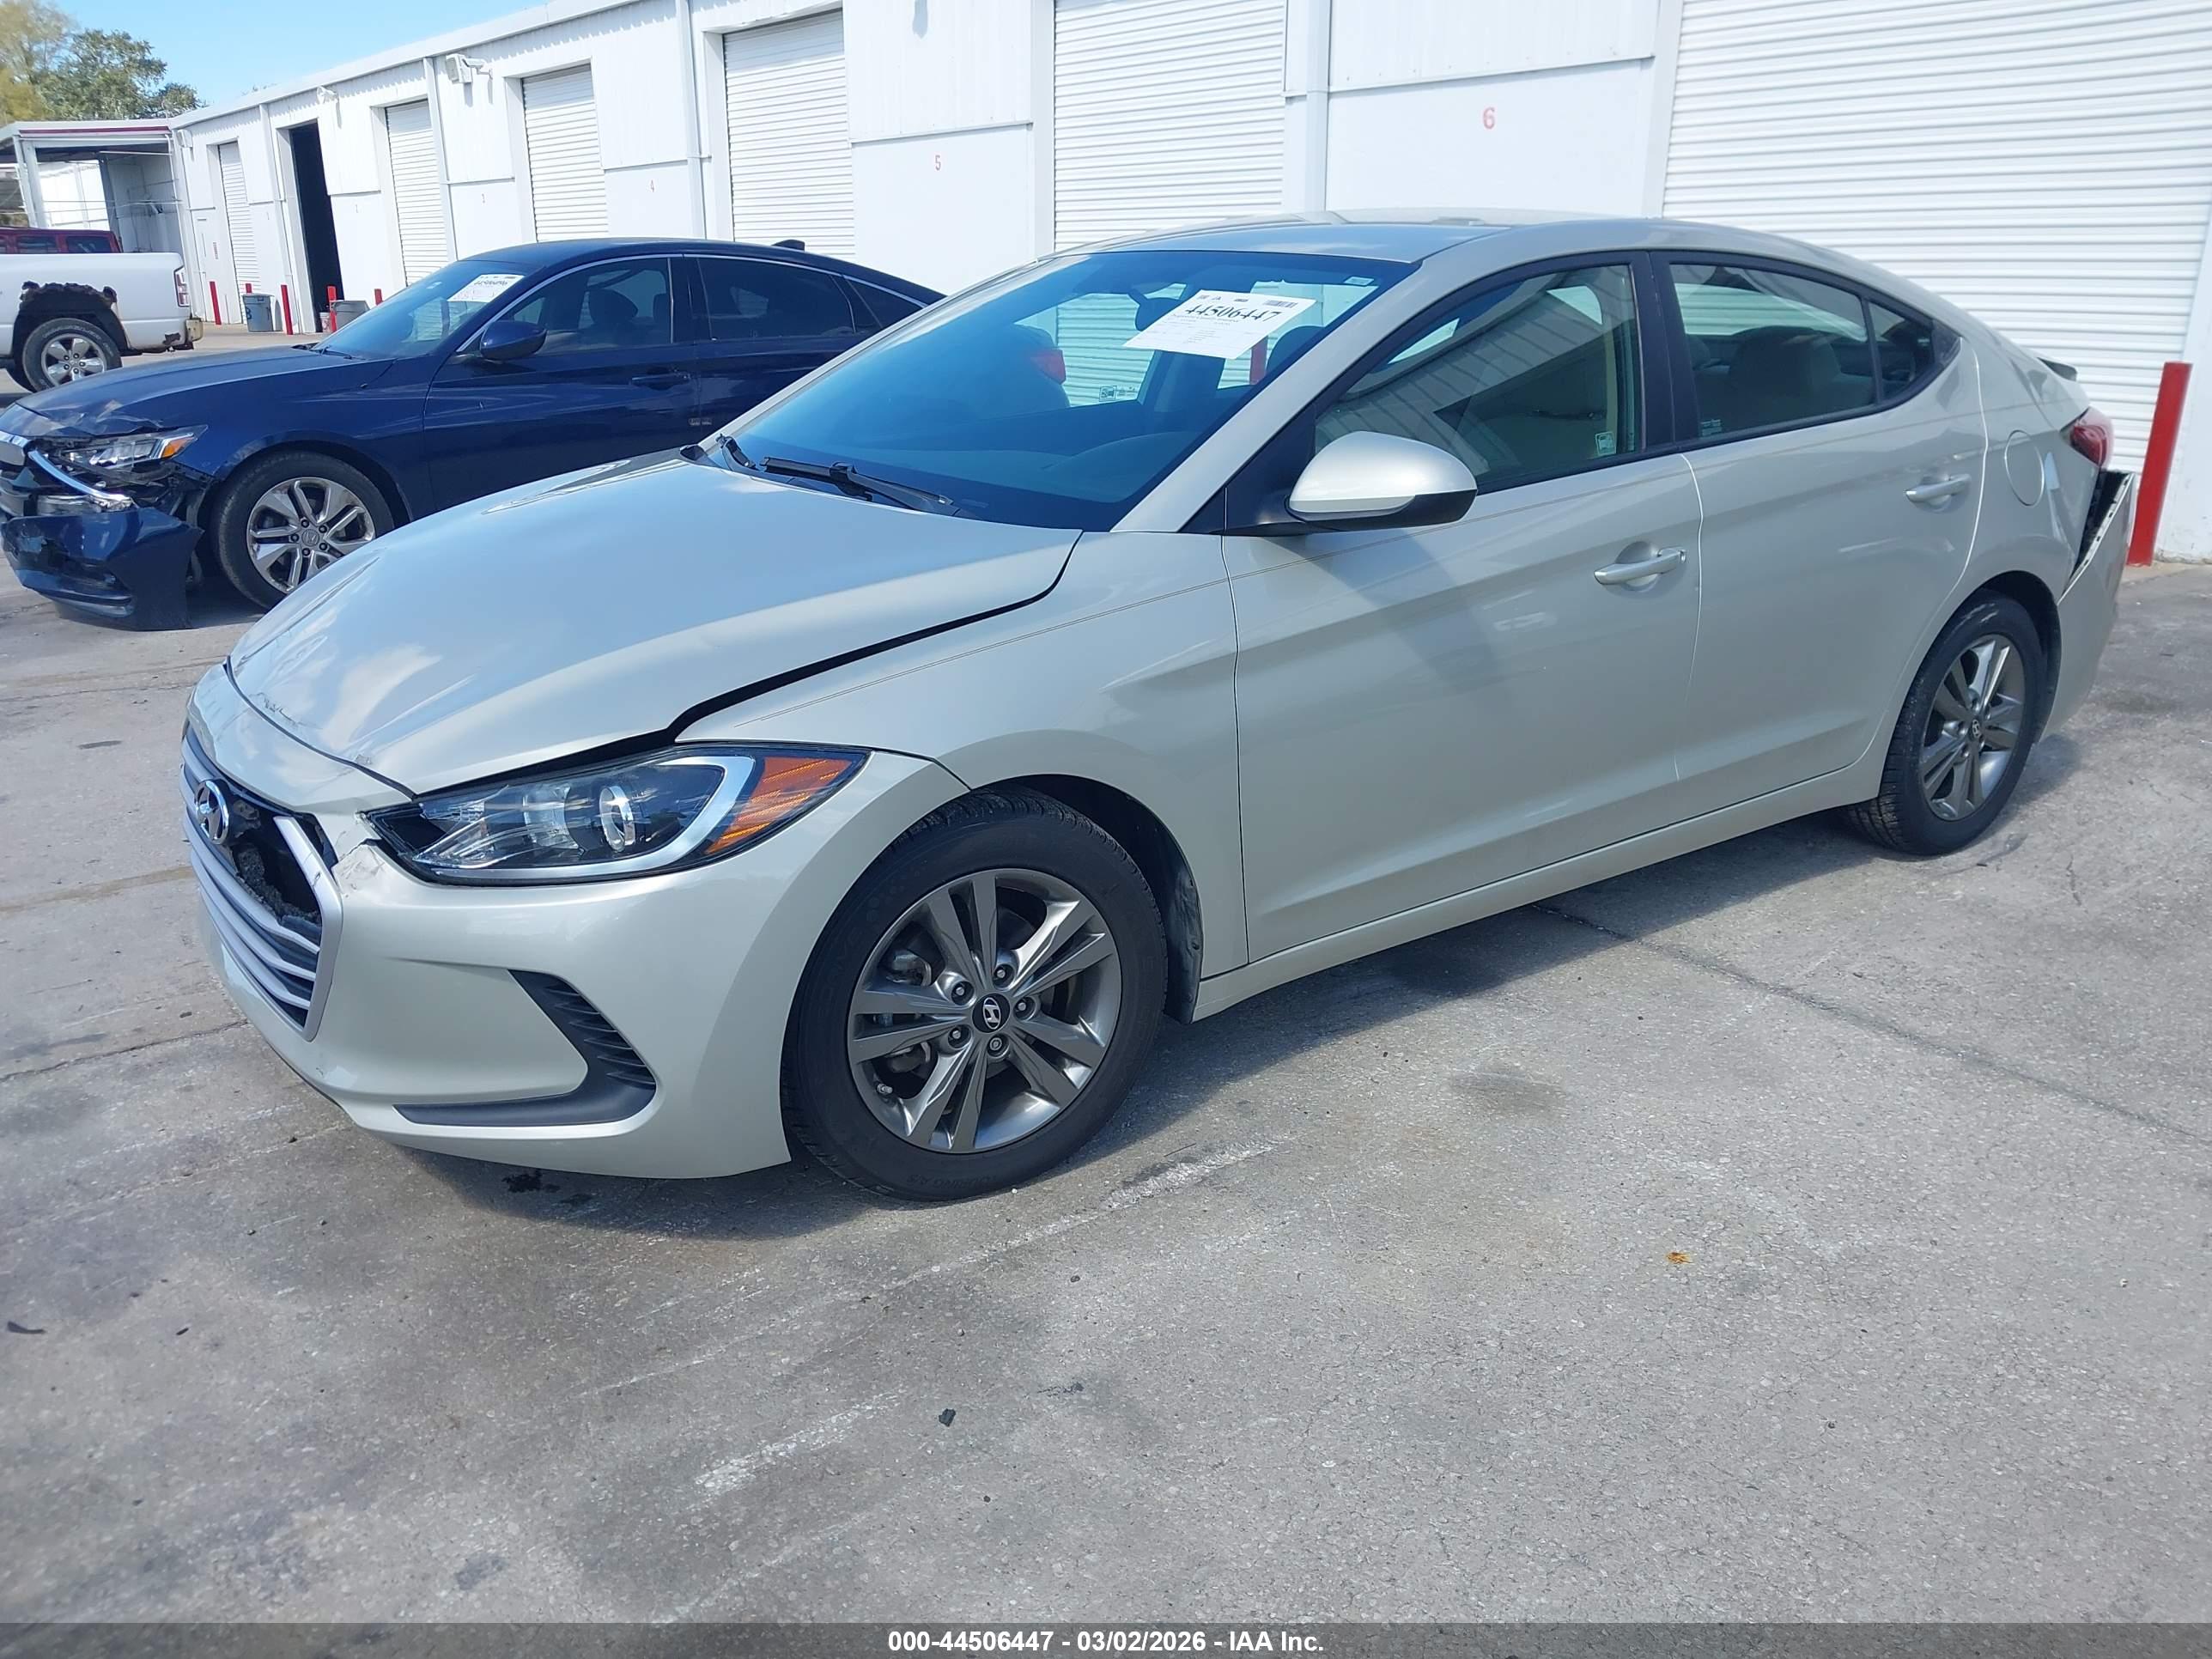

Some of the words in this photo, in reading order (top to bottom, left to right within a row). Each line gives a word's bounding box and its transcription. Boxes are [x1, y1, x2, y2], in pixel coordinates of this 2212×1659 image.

[1483, 106, 1495, 130] 6
[934, 154, 941, 172] 5
[1185, 304, 1282, 322] 44506447
